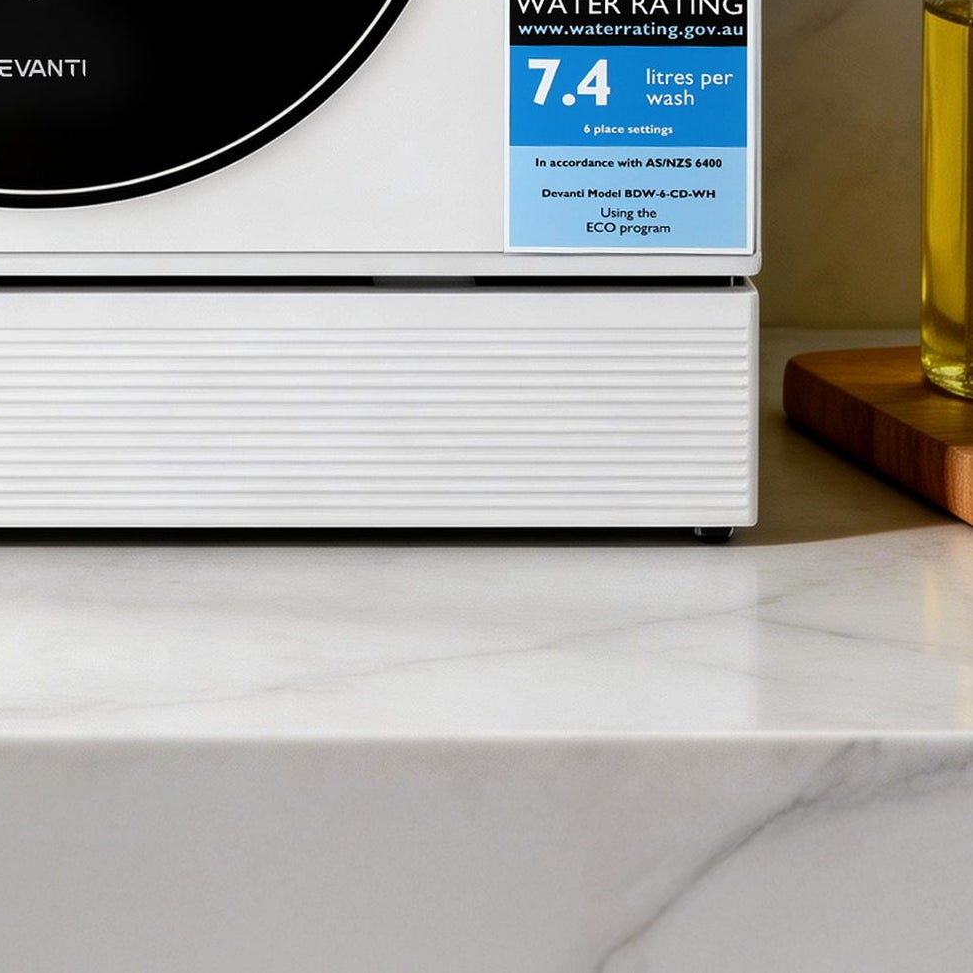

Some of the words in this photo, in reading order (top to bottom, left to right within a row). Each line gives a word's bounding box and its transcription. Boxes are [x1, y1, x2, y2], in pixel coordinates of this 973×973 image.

[519, 22, 743, 39] www.waterrating.gov.au
[528, 59, 611, 106] 7.4
[646, 68, 694, 85] litres
[701, 72, 733, 89] per
[646, 90, 695, 106] wash
[584, 125, 590, 134] 6
[594, 125, 625, 136] place
[628, 125, 673, 136] settings
[536, 158, 546, 167] In
[550, 158, 614, 168] accordance
[618, 158, 643, 167] with
[646, 158, 692, 168] AS/NZS
[695, 158, 722, 168] 6400
[542, 189, 584, 198] Devanti
[588, 189, 621, 198] Model
[625, 189, 716, 199] BDW-6-CD-WH
[600, 207, 634, 220] Using
[637, 208, 657, 218] the
[586, 222, 616, 233] ECO
[620, 223, 671, 235] program
